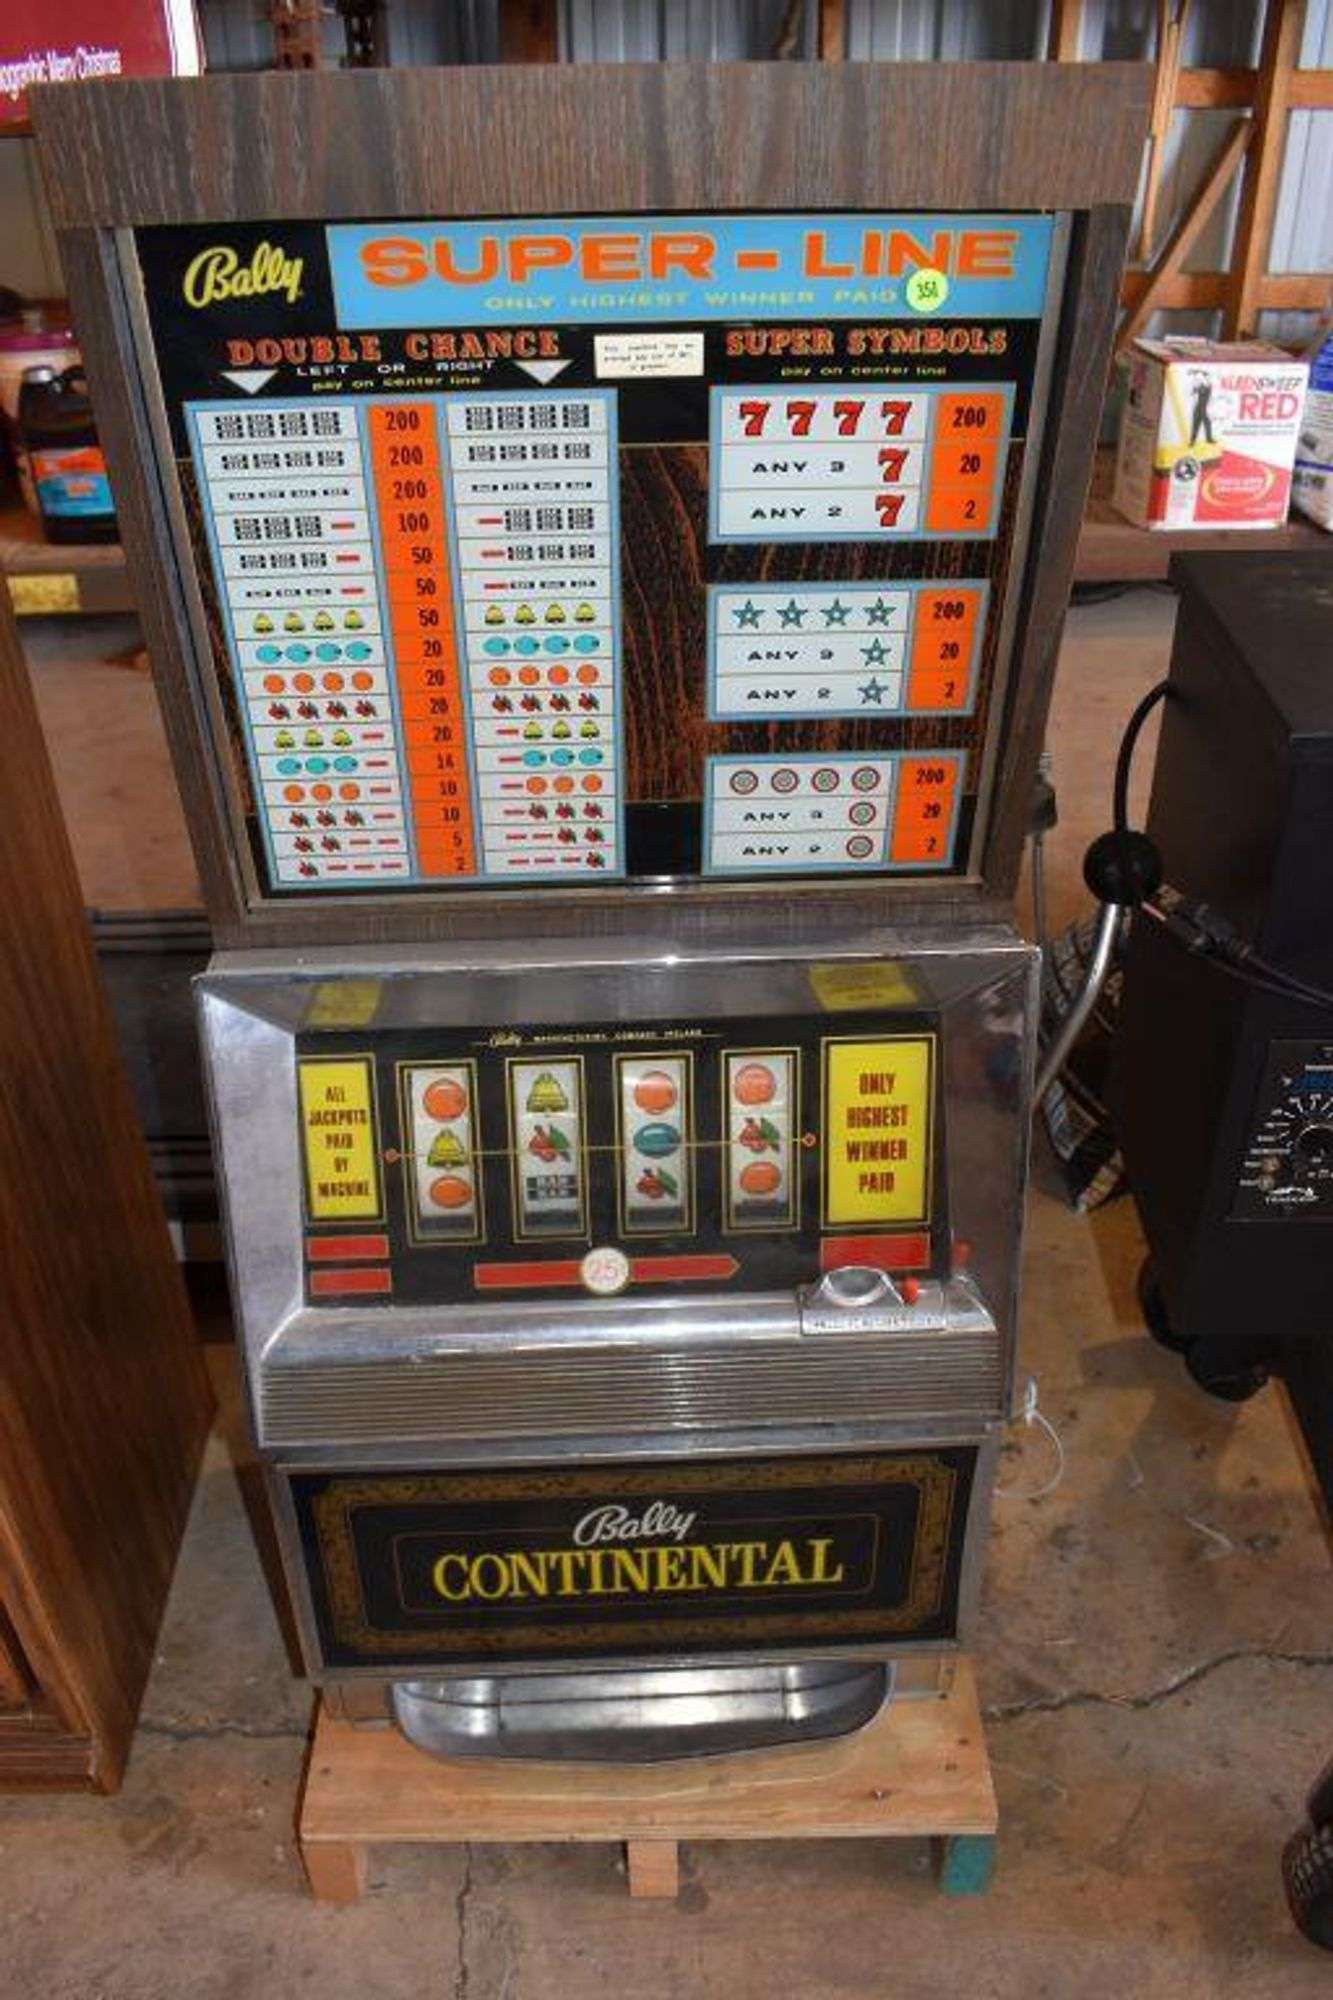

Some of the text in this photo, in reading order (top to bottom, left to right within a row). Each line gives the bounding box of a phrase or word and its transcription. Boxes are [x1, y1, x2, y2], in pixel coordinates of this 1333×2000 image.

[360, 230, 1017, 288] SUPER - LINE
[184, 241, 303, 308] Bally
[486, 289, 897, 310] ONLY HIGHEST WINNER PAID
[227, 331, 560, 365] DOUBLE CHANCE
[726, 328, 1007, 356] SUPER SYMBOLS
[296, 360, 496, 376] LEFT OR RIGHT
[780, 365, 947, 377] pay on center line
[312, 374, 482, 392] pay on center line
[1239, 393, 1299, 420] RED
[385, 410, 420, 431] 200
[739, 400, 986, 437] 7 7 7 7 200
[389, 446, 423, 467] 200
[752, 447, 981, 483] ANY 3 7 20
[393, 479, 427, 500] 200
[750, 494, 976, 527] ANY 2 7 2
[398, 512, 430, 533] 100
[411, 546, 433, 564] 50
[415, 578, 436, 596] 50
[418, 608, 439, 627] 50
[933, 601, 965, 620] 200
[423, 639, 443, 658] 20
[747, 642, 960, 661] ANY 3 20
[425, 669, 446, 687] 20
[747, 689, 797, 700] ANY
[944, 681, 955, 699] 2
[429, 697, 449, 715] 20
[916, 768, 945, 785] 200
[439, 780, 457, 796] 10
[442, 806, 460, 822] 10
[743, 811, 791, 821] ANY
[922, 802, 941, 820] 20
[452, 831, 463, 847] 5
[742, 845, 789, 856] ANY
[927, 836, 937, 853] 2
[455, 856, 465, 872] 2
[859, 1072, 896, 1095] ONLY
[325, 1086, 345, 1102] ALL
[309, 1108, 367, 1126] JACKPOTS
[846, 1104, 907, 1128] HIGHEST
[325, 1132, 353, 1149] PAID
[846, 1138, 907, 1162] WINNER
[334, 1156, 348, 1173] BY
[318, 1181, 369, 1197] MACHINE
[859, 1171, 895, 1194] PAID
[572, 1501, 699, 1547] Bally
[433, 1538, 844, 1600] CONTINENTAL
